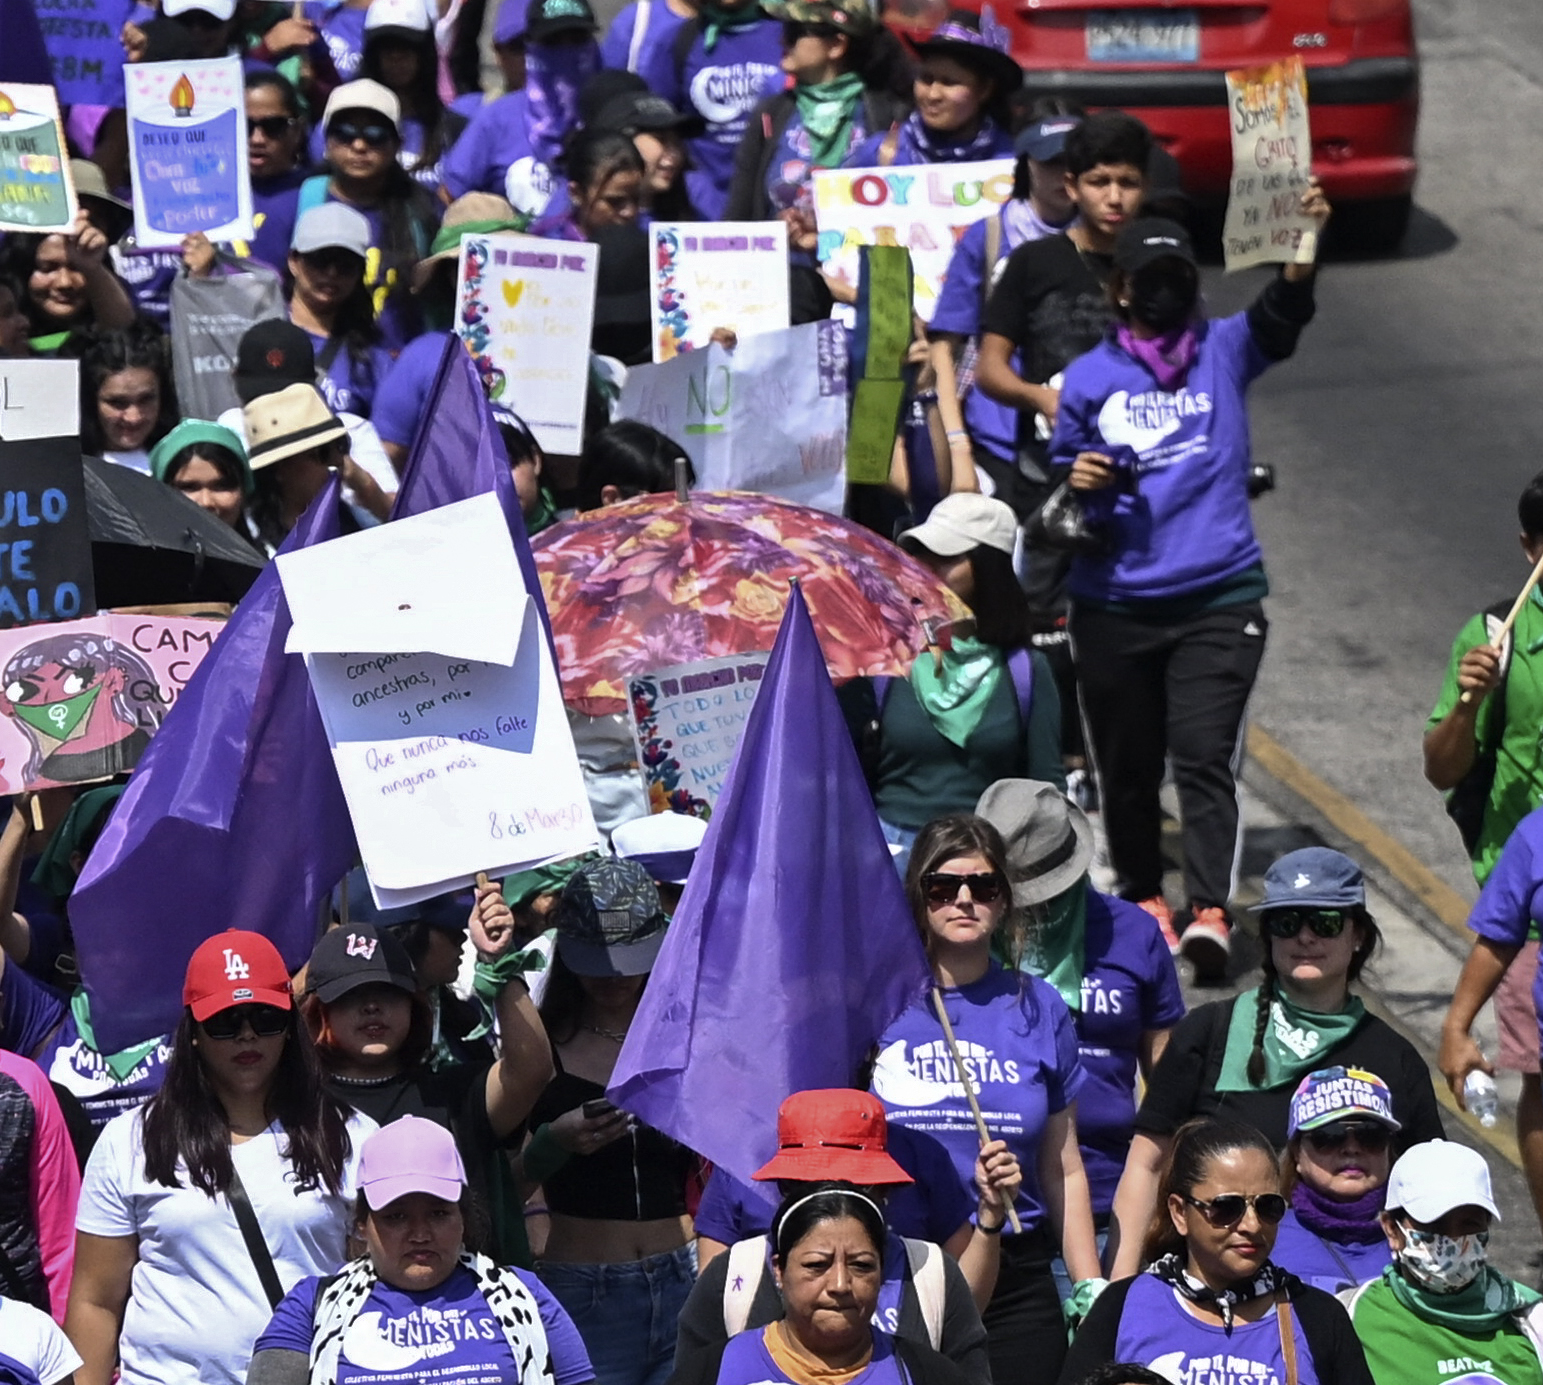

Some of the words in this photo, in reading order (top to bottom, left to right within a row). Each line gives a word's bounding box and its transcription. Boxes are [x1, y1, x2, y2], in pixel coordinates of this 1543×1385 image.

[815, 173, 913, 208] HOY
[352, 675, 436, 708] ancestras,
[398, 710, 412, 725] y
[416, 698, 437, 718] por
[442, 690, 462, 705] mi
[365, 747, 396, 771] Que
[402, 734, 448, 761] nunca
[458, 729, 489, 743] nos
[495, 717, 529, 735] falte
[380, 770, 437, 795] ninguna
[489, 812, 503, 840] 8
[508, 818, 526, 836] de
[224, 947, 250, 981] LA
